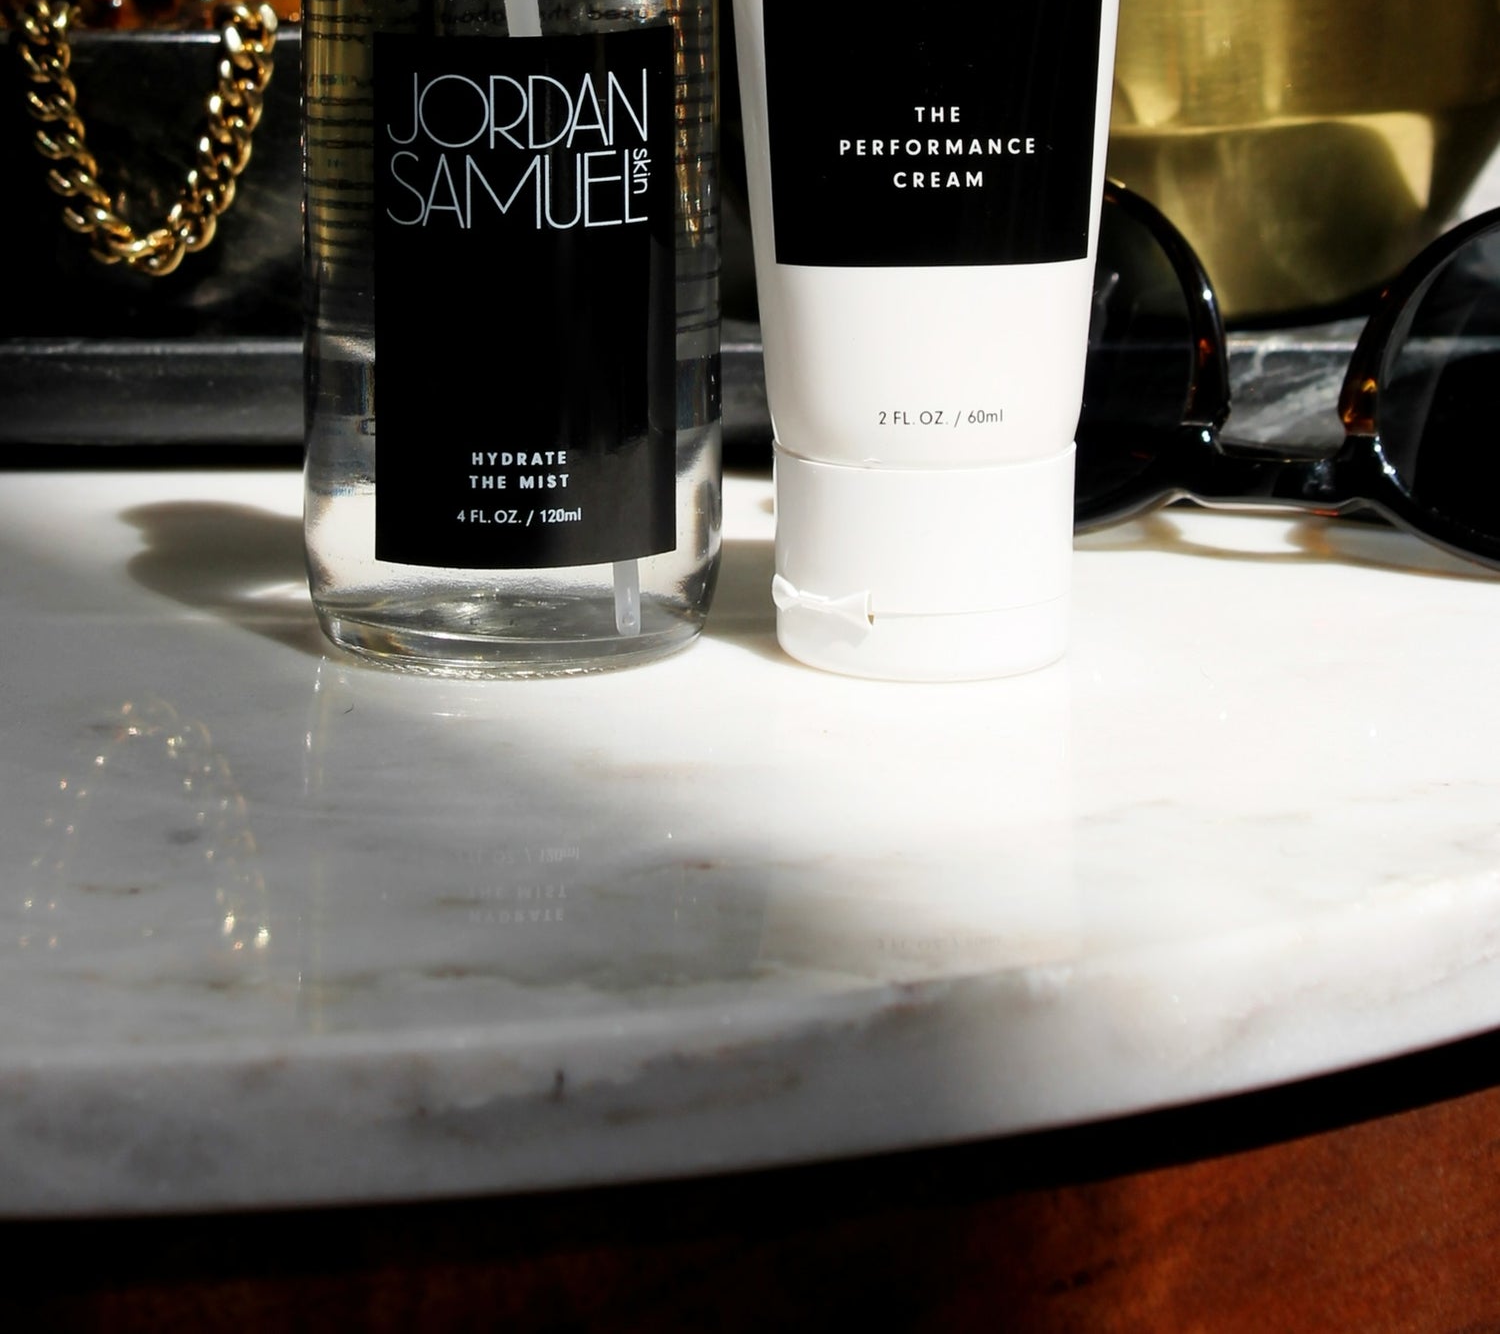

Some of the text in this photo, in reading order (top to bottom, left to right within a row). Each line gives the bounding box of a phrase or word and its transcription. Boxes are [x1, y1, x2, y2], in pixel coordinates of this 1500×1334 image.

[387, 68, 648, 150] JORDAN
[914, 106, 960, 123] THE
[839, 137, 1035, 156] PERFORMANCE
[632, 148, 652, 195] skin
[893, 170, 984, 189] CREAM
[386, 150, 649, 229] SAMUEL
[878, 410, 888, 426] 2
[967, 409, 1004, 425] 60ml
[472, 450, 567, 466] HYDRATE
[469, 473, 569, 489] THE MIST
[456, 510, 466, 523] 4
[525, 510, 535, 527] /
[540, 507, 582, 523] 120ml
